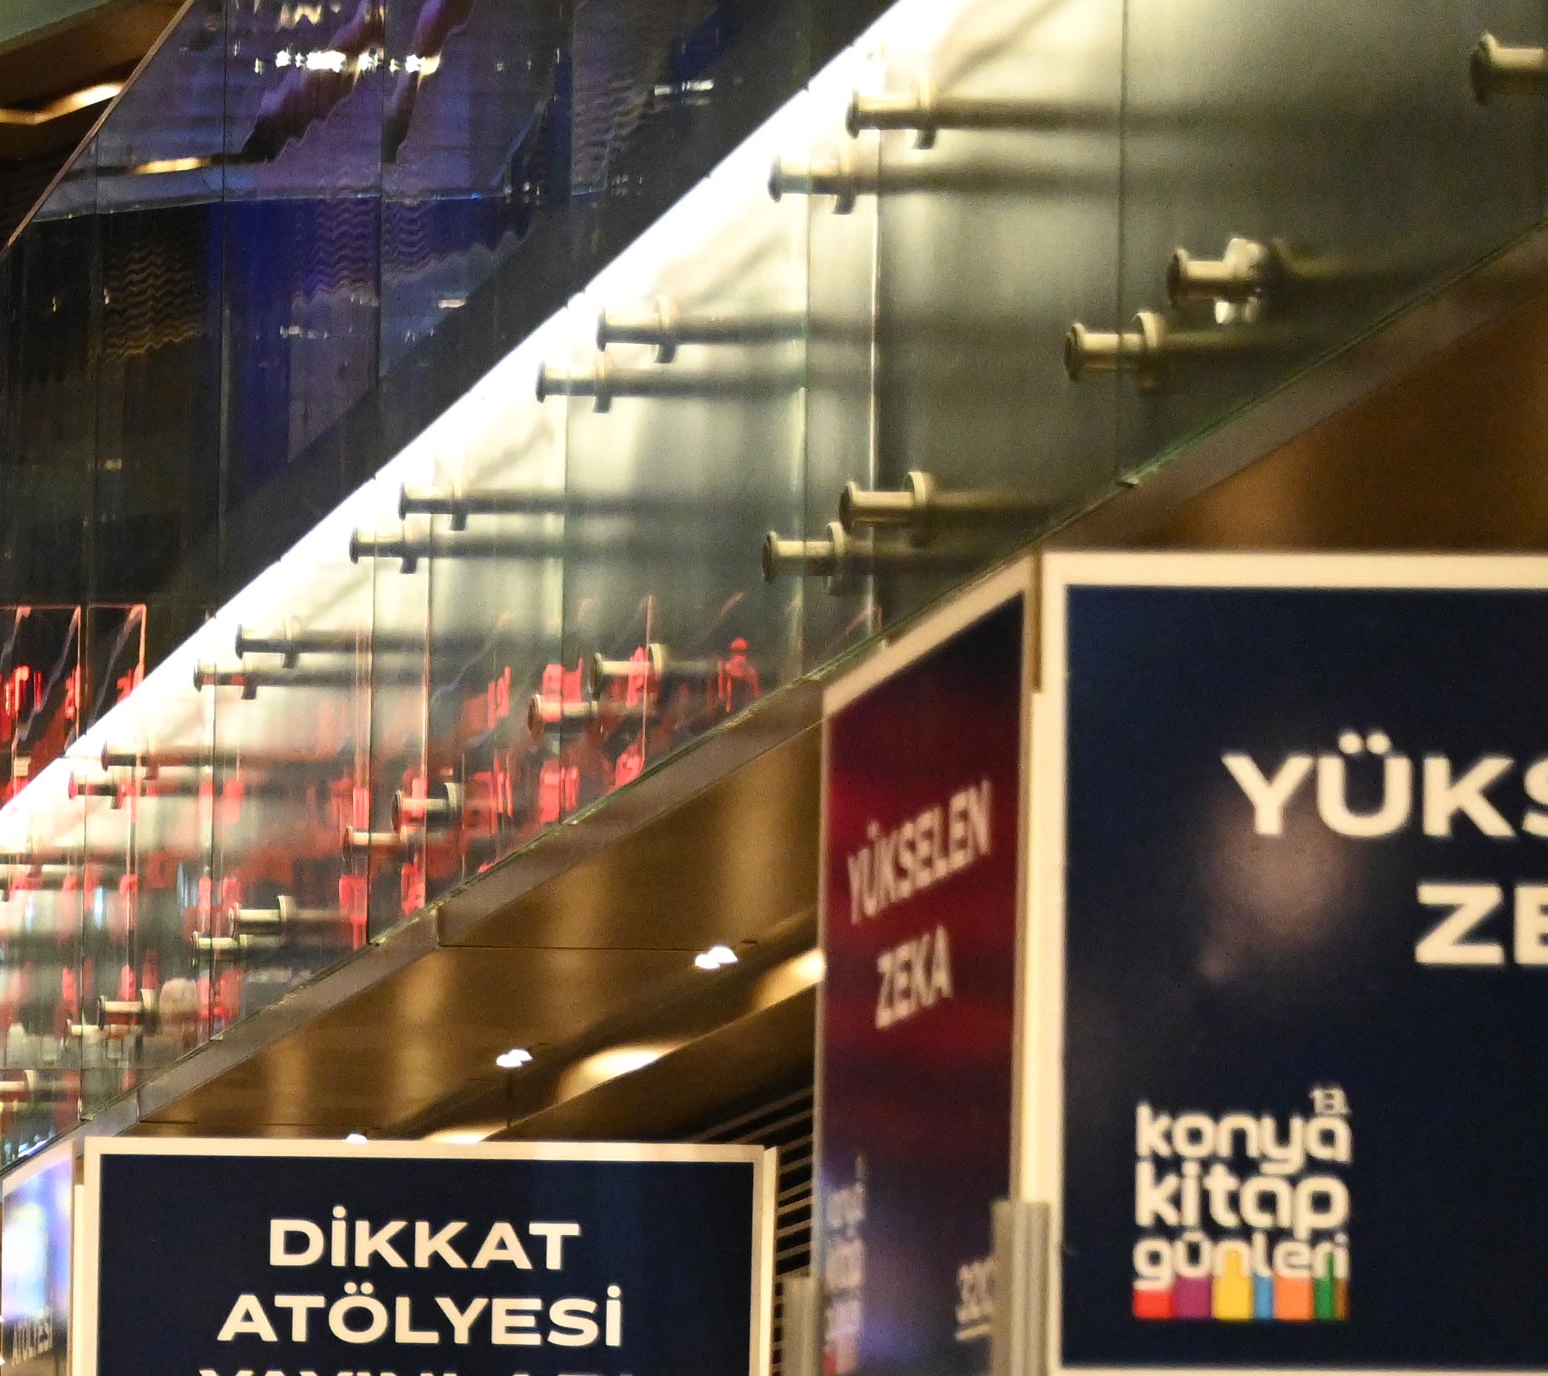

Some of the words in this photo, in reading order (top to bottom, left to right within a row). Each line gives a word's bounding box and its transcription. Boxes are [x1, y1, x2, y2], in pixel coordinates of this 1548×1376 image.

[846, 778, 992, 923] YÜKSELEN
[874, 924, 952, 1030] ZEKA
[1136, 1102, 1351, 1176] konya
[269, 1205, 581, 1270] DİKKAT
[1134, 1160, 1349, 1241] kitap
[1132, 1232, 1348, 1292] günleri
[217, 1281, 623, 1346] ATÖLYESİ
